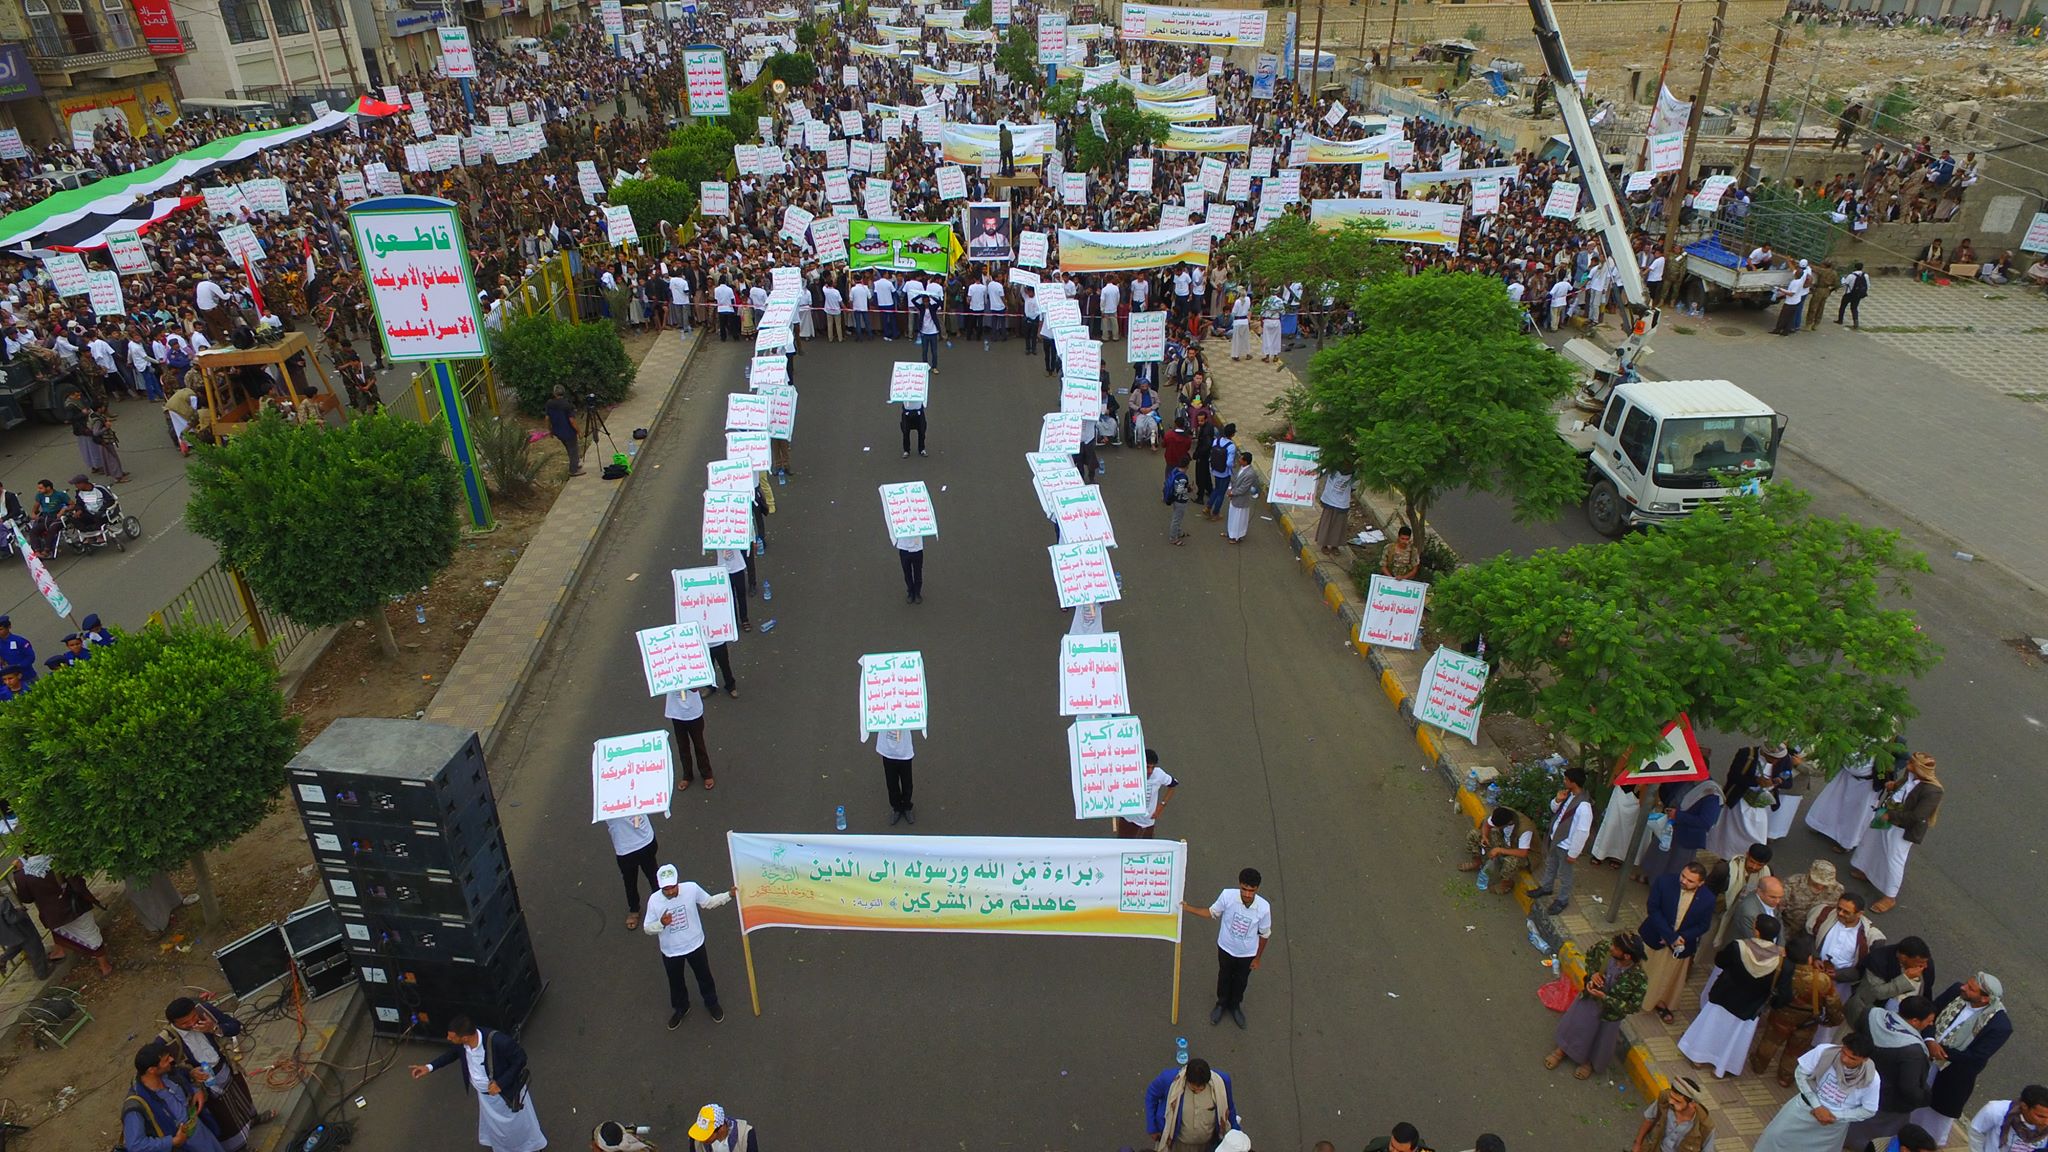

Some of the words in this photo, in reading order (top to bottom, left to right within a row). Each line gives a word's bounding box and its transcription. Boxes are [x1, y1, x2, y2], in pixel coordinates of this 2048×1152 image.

[144, 15, 168, 25] اليمن
[365, 225, 451, 259] قاطعوا
[371, 262, 422, 291] الأمريكية
[422, 265, 464, 289] البضائع
[421, 293, 429, 311] و
[386, 316, 475, 342] الإسرائيلية
[680, 571, 725, 591] قاطعوا
[1377, 582, 1420, 599] قاطعوا
[707, 592, 728, 606] البضائع
[704, 610, 707, 620] و
[1396, 602, 1418, 615] البضائع
[1388, 616, 1393, 626] و
[1068, 638, 1117, 657] قاطعوا
[900, 655, 920, 669] الله
[1096, 660, 1120, 677] البضائع
[898, 673, 921, 684] الموت
[1091, 677, 1096, 689] و
[899, 688, 922, 697] الموت
[868, 701, 888, 713] اليهود
[891, 700, 902, 711] على
[900, 711, 924, 726] النصر
[1117, 722, 1139, 738] الله
[603, 736, 662, 762] قاطعوا
[1114, 743, 1140, 757] الموت
[601, 760, 634, 781] الأمريكية
[636, 759, 665, 774] البضائع
[1115, 762, 1141, 775] الموت
[630, 779, 634, 790] و
[1083, 781, 1105, 795] اليهود
[1107, 778, 1120, 793] على
[1123, 777, 1142, 790] اللعنة
[1117, 791, 1145, 812] النصر
